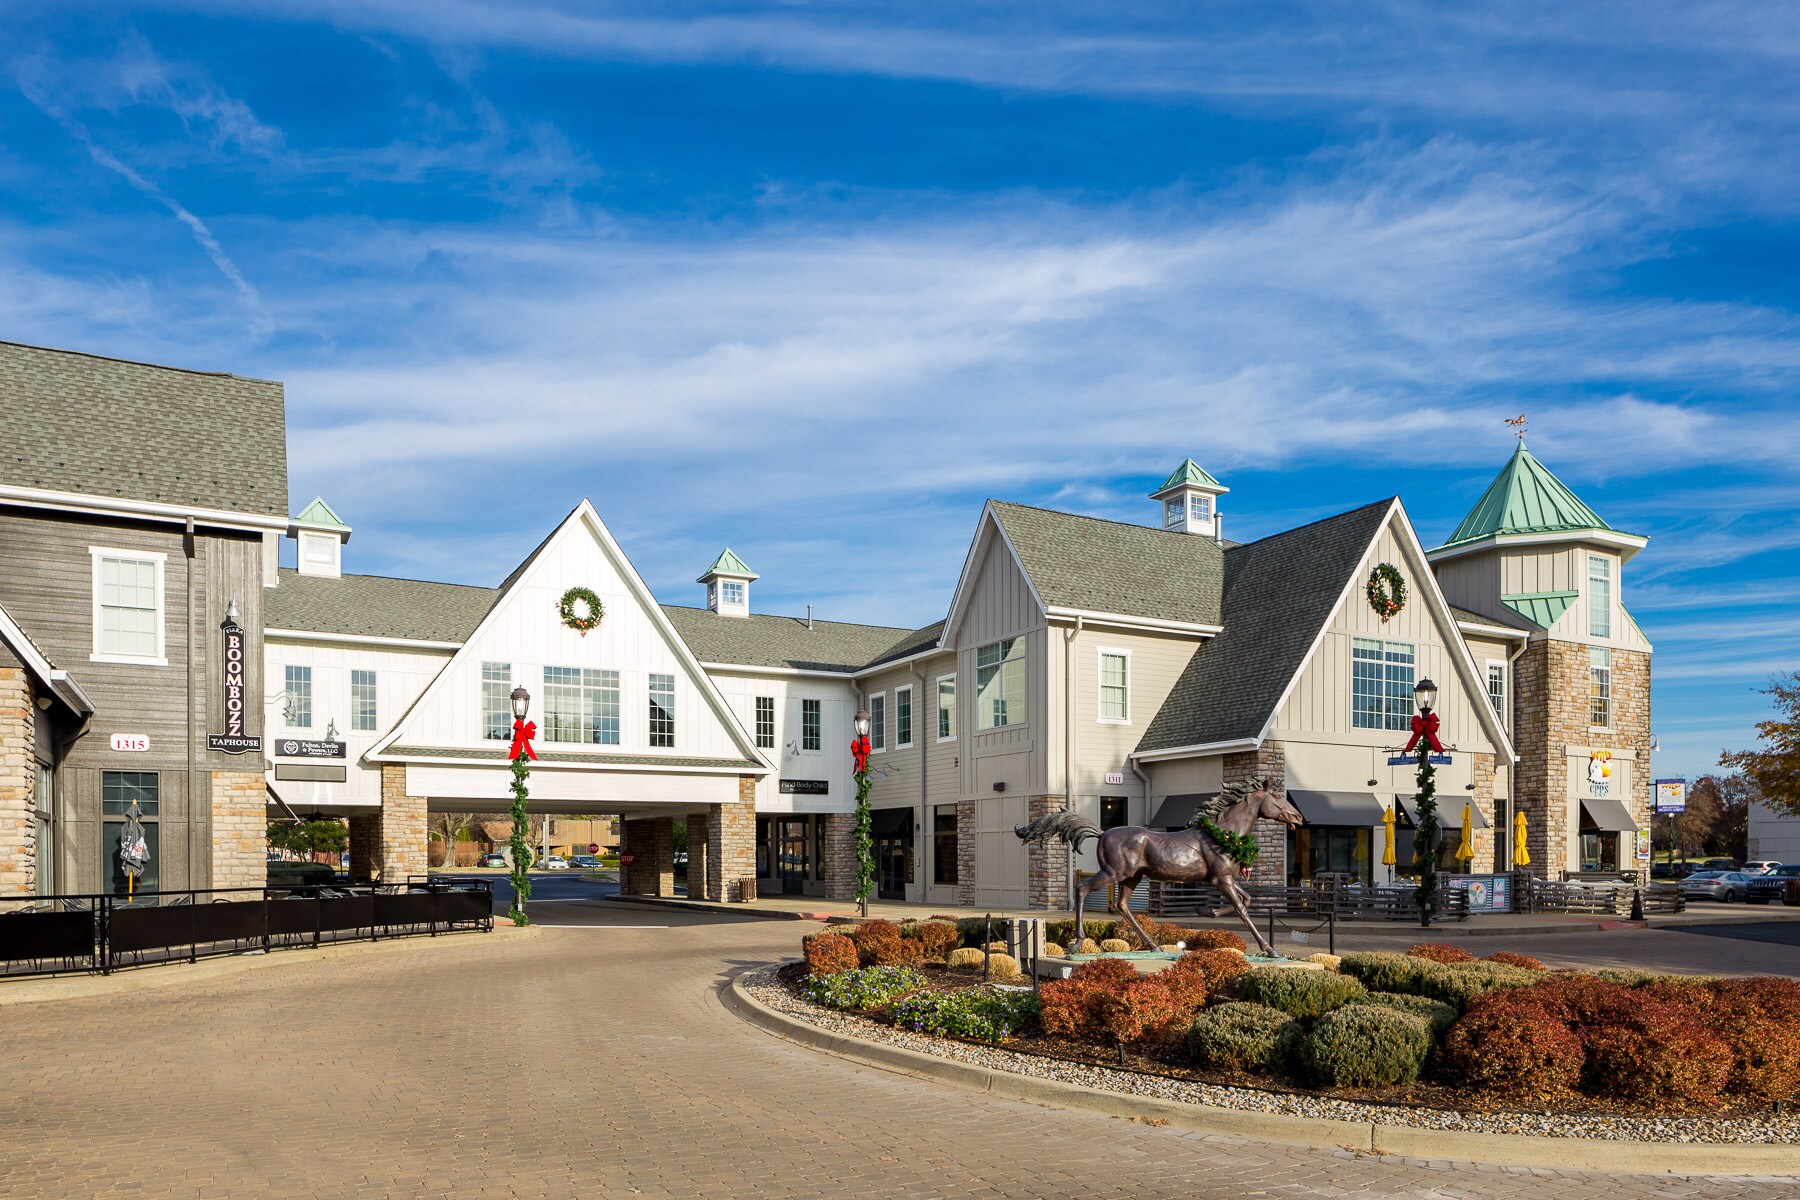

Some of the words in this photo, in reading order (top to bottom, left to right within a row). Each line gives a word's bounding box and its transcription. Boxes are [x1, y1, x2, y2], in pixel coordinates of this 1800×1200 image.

[225, 635, 244, 737] BOOMBOZZ
[116, 739, 145, 750] 1315
[211, 738, 259, 747] TAPHOUSE
[1590, 750, 1613, 763] WILD
